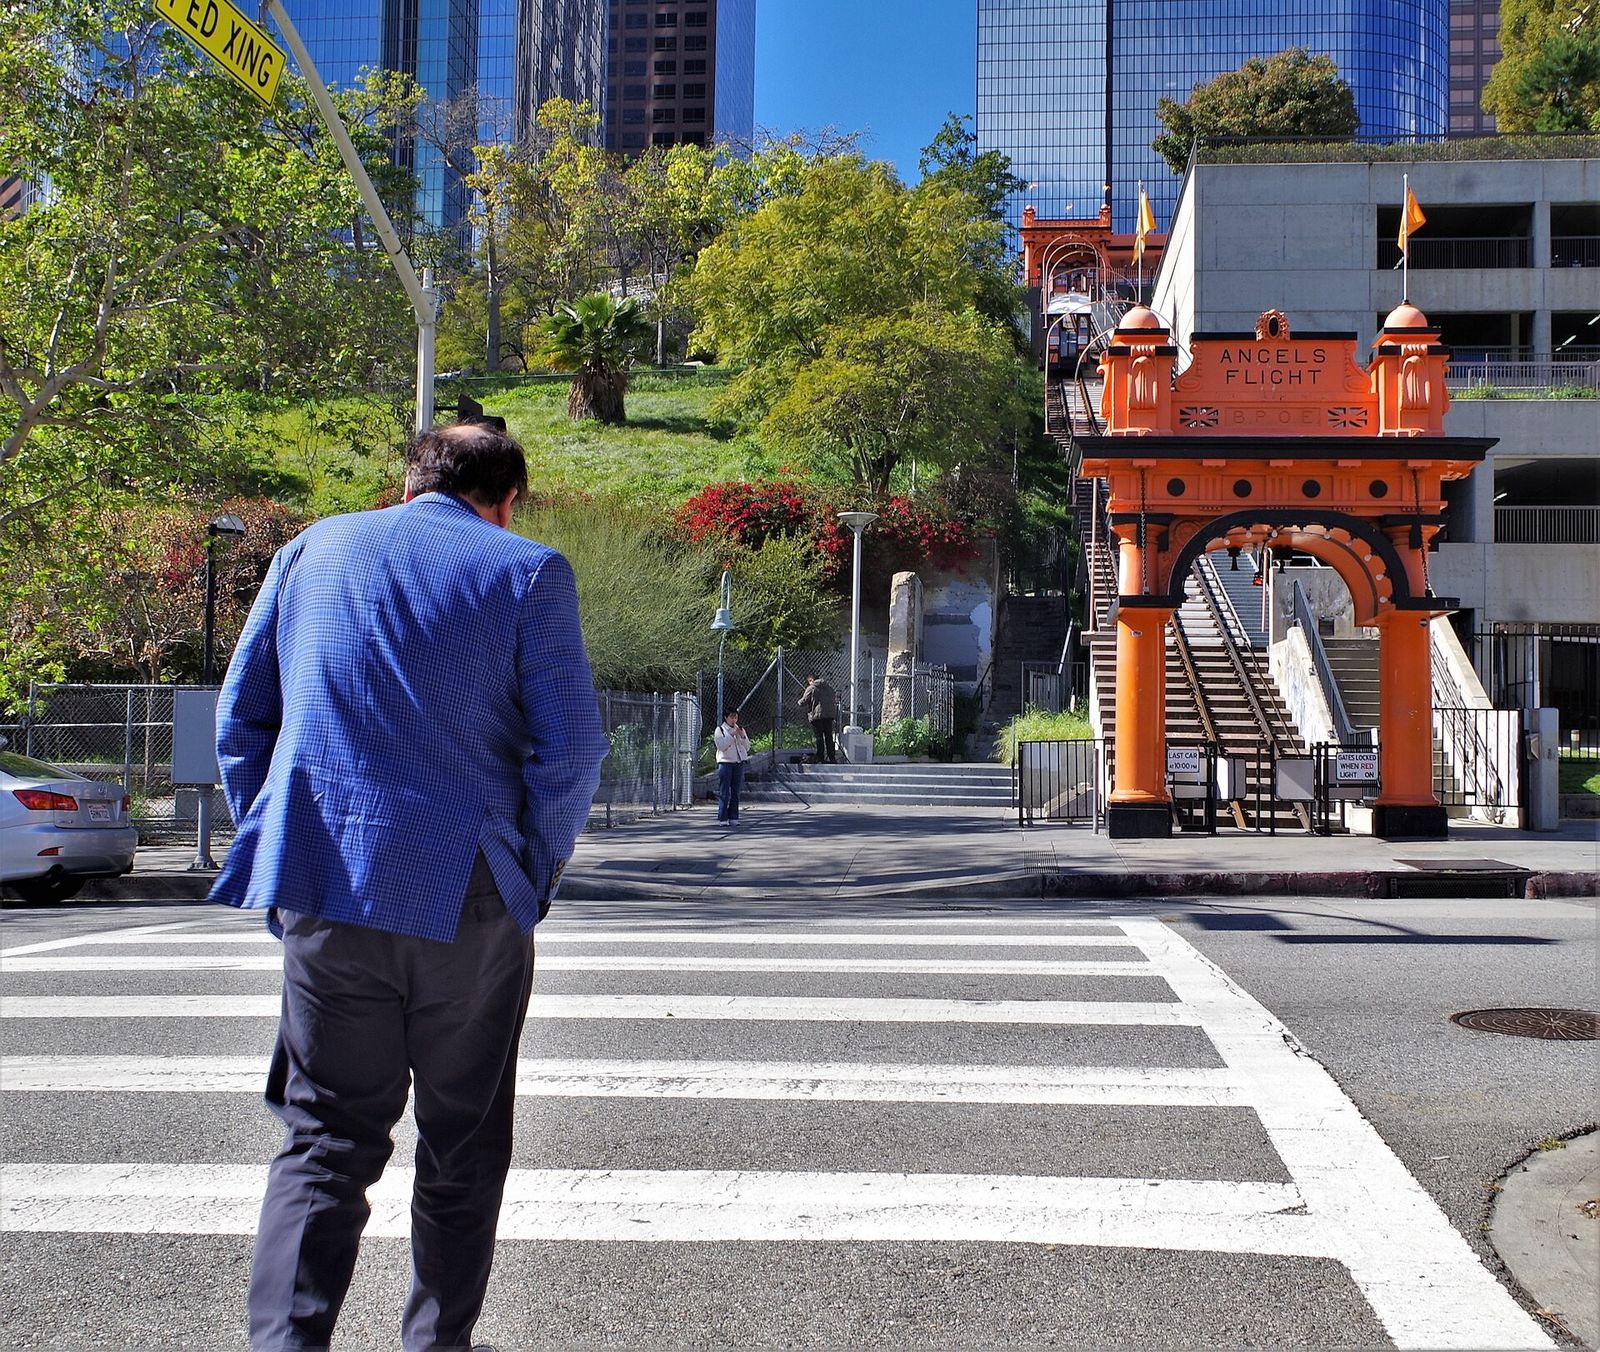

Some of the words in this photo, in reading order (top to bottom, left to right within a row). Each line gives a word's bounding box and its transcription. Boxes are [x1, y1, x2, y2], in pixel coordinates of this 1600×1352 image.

[169, 0, 219, 38] ED
[222, 20, 273, 88] XING
[1220, 348, 1326, 363] ANGELS
[1226, 369, 1321, 384] FLIGHT
